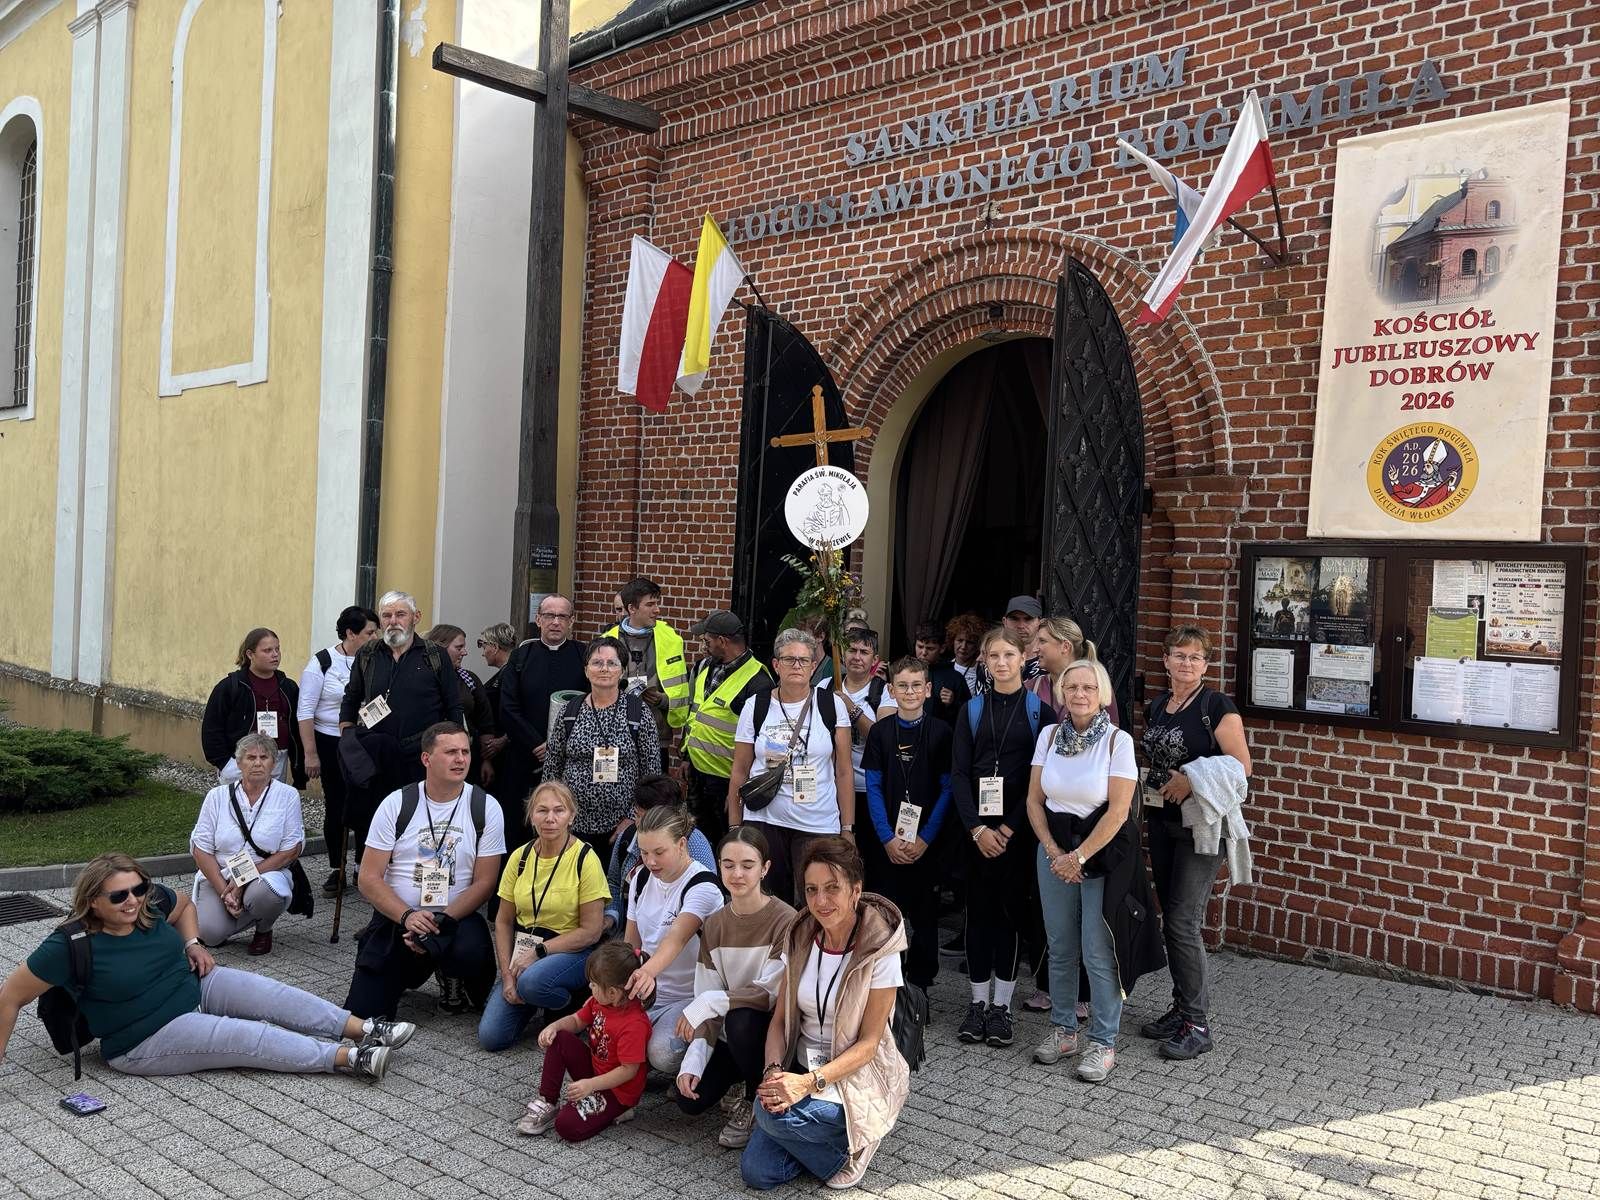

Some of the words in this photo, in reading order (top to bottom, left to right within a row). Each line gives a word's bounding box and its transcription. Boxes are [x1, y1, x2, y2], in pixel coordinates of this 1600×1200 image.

[844, 46, 1189, 168] SANKTUARIUM
[728, 140, 1091, 245] ŁOGOSŁAWIONEGO
[1373, 307, 1496, 336] KOŚCIÓŁ
[1332, 332, 1540, 369] JUBILEUSZOWY
[1369, 360, 1494, 387] DOBRÓW
[1400, 391, 1455, 410] 2026
[1373, 448, 1388, 465] ROK
[1386, 425, 1434, 447] ŚWIĘTEGO
[1437, 427, 1474, 463] BOGUMIŁA
[1402, 453, 1419, 464] 20
[1403, 442, 1421, 451] A.D.
[792, 474, 814, 496] PARAFIA
[828, 470, 857, 490] MIKOŁAJA
[1402, 465, 1418, 476] 26
[1373, 487, 1406, 518] DIECEZJA
